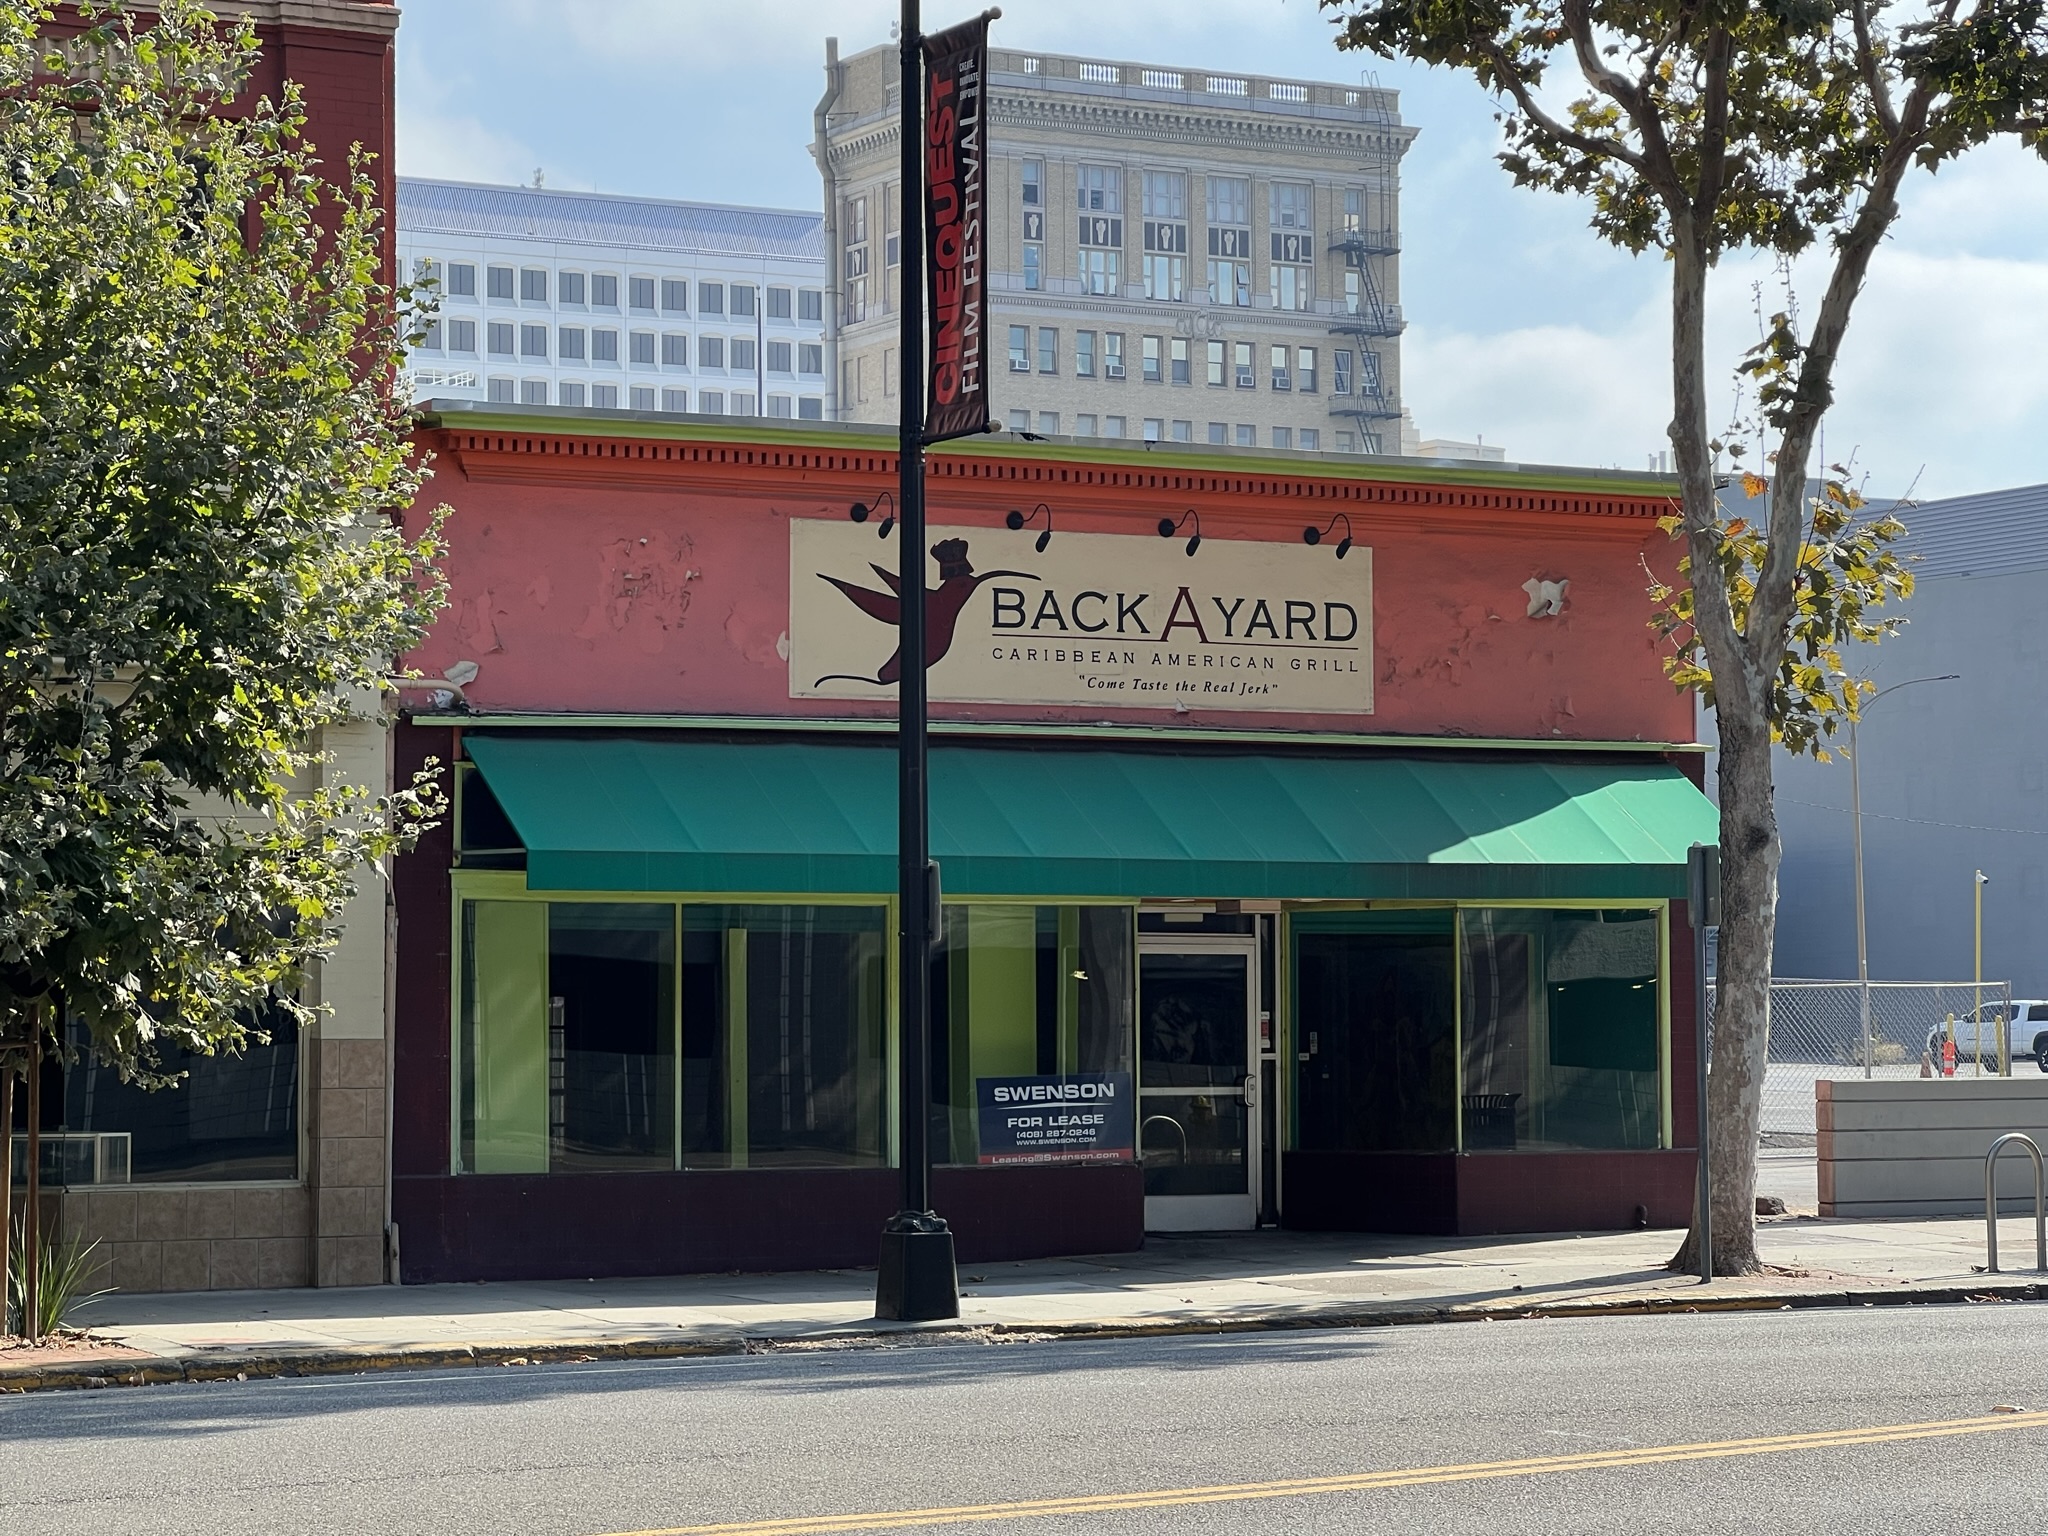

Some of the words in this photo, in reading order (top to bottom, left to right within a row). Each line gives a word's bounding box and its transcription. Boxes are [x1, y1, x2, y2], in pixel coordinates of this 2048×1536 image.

[960, 103, 980, 286] FESTIVAL
[929, 72, 963, 405] CINEQUEST
[961, 300, 979, 394] FILM
[992, 647, 1135, 665] CARIBBEAN
[1151, 652, 1274, 669] AMERICAN
[1290, 658, 1358, 672] GRILL
[1078, 675, 1125, 690] "Come
[1132, 678, 1168, 691] Taste
[1175, 681, 1196, 692] the
[1203, 681, 1235, 693] Real
[1238, 683, 1278, 696] Jerk"
[994, 1083, 1115, 1102] SWENSON
[1008, 1116, 1043, 1128] FOR
[1048, 1114, 1104, 1127] LEASE
[1016, 1131, 1043, 1139] (408)
[1016, 1136, 1097, 1146] WWW.SWENSON.COM
